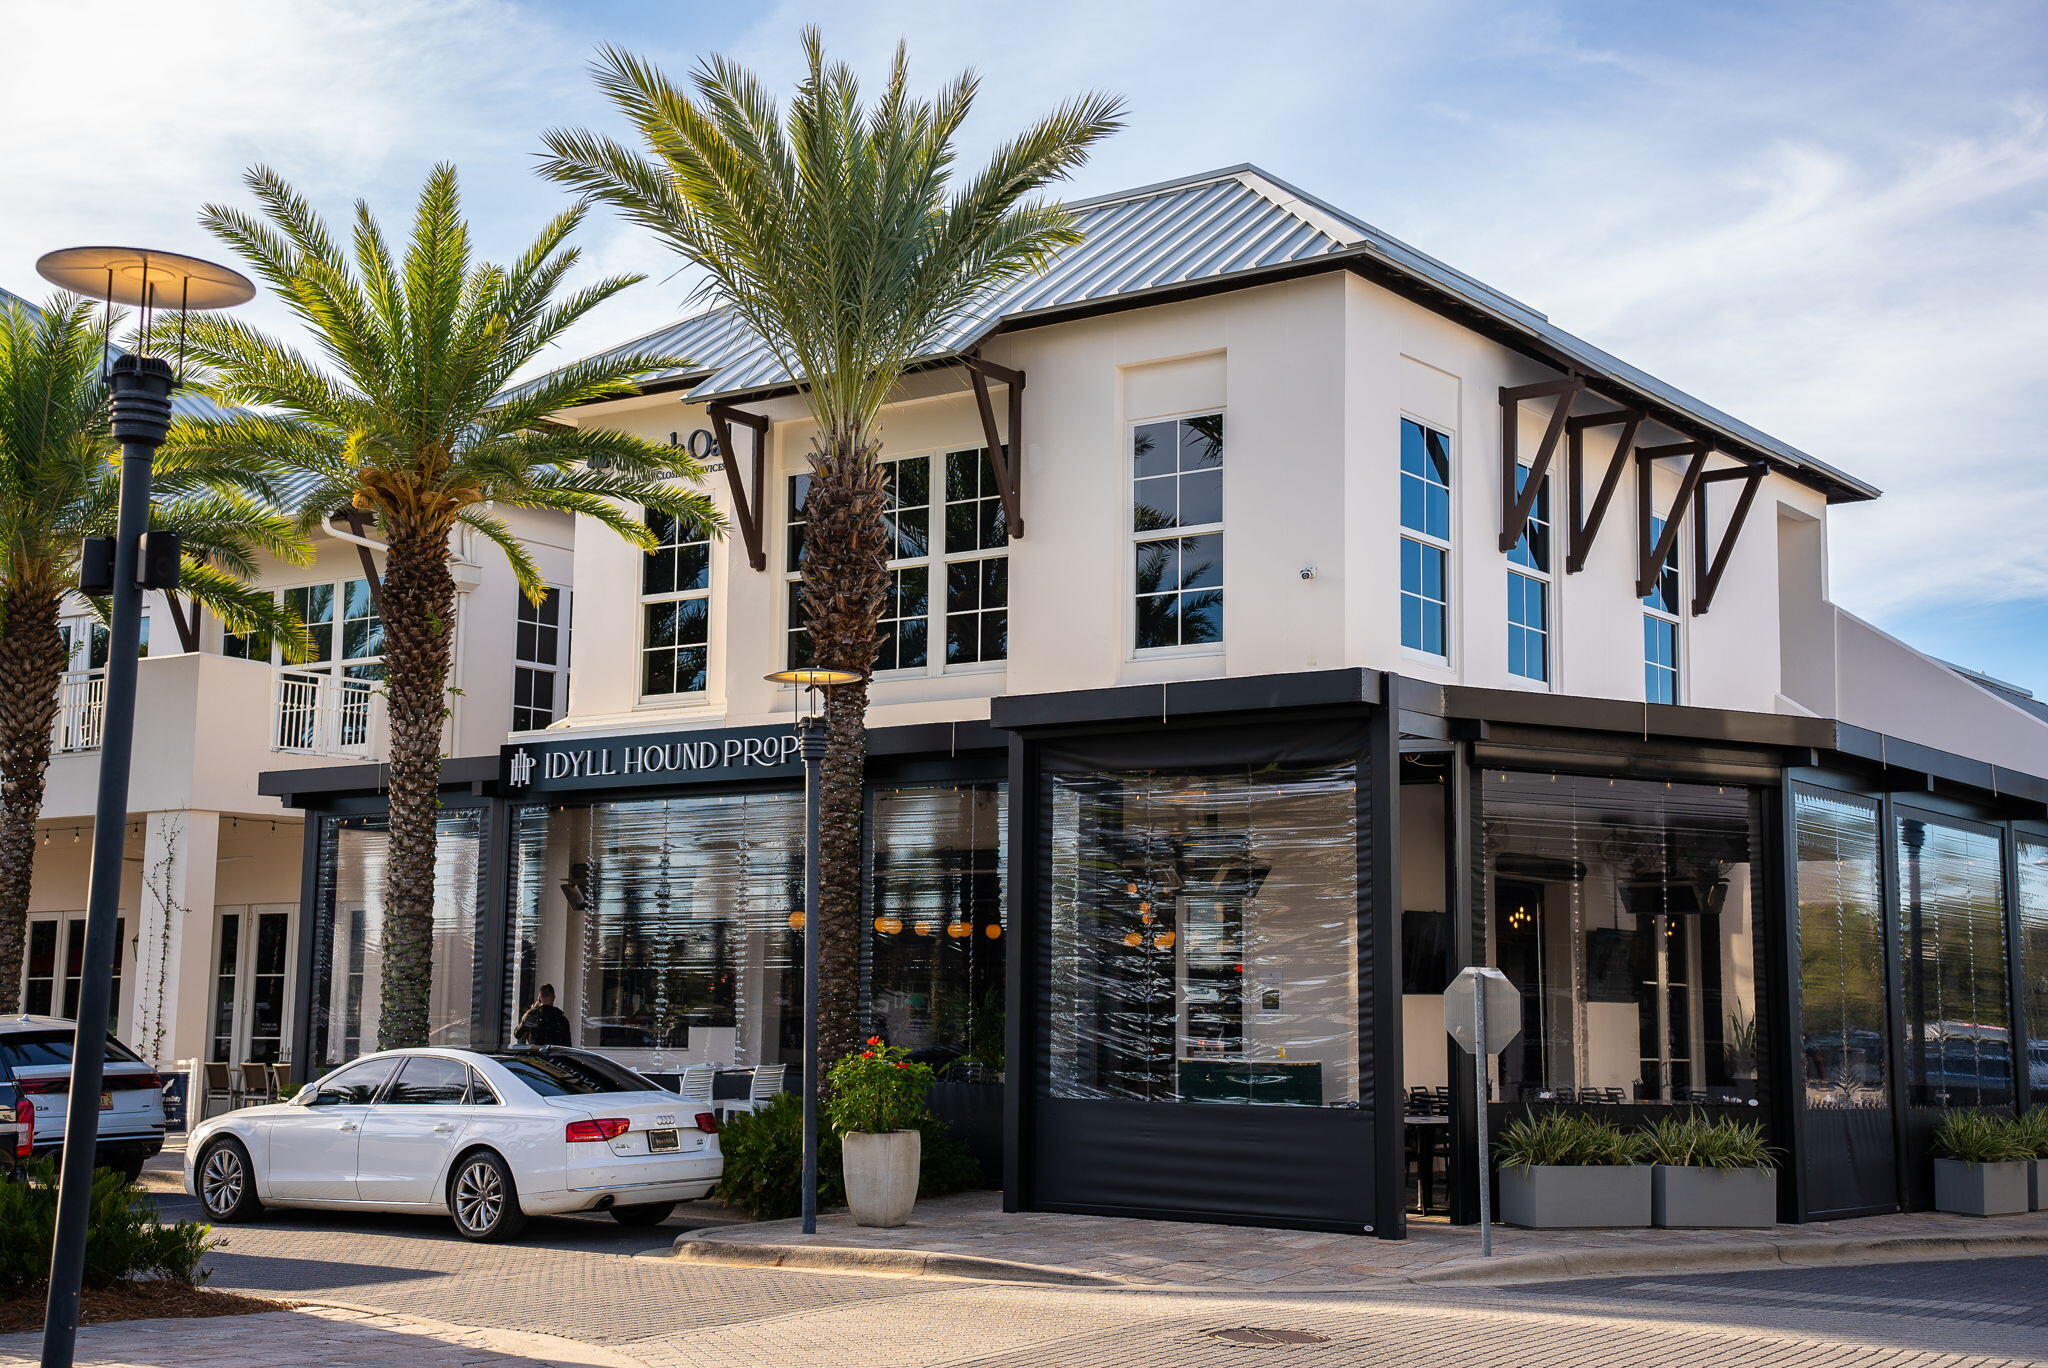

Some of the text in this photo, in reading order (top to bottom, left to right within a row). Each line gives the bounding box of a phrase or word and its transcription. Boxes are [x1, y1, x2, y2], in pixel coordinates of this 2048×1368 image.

[544, 735, 800, 779] IDYLL HOUND PROP
